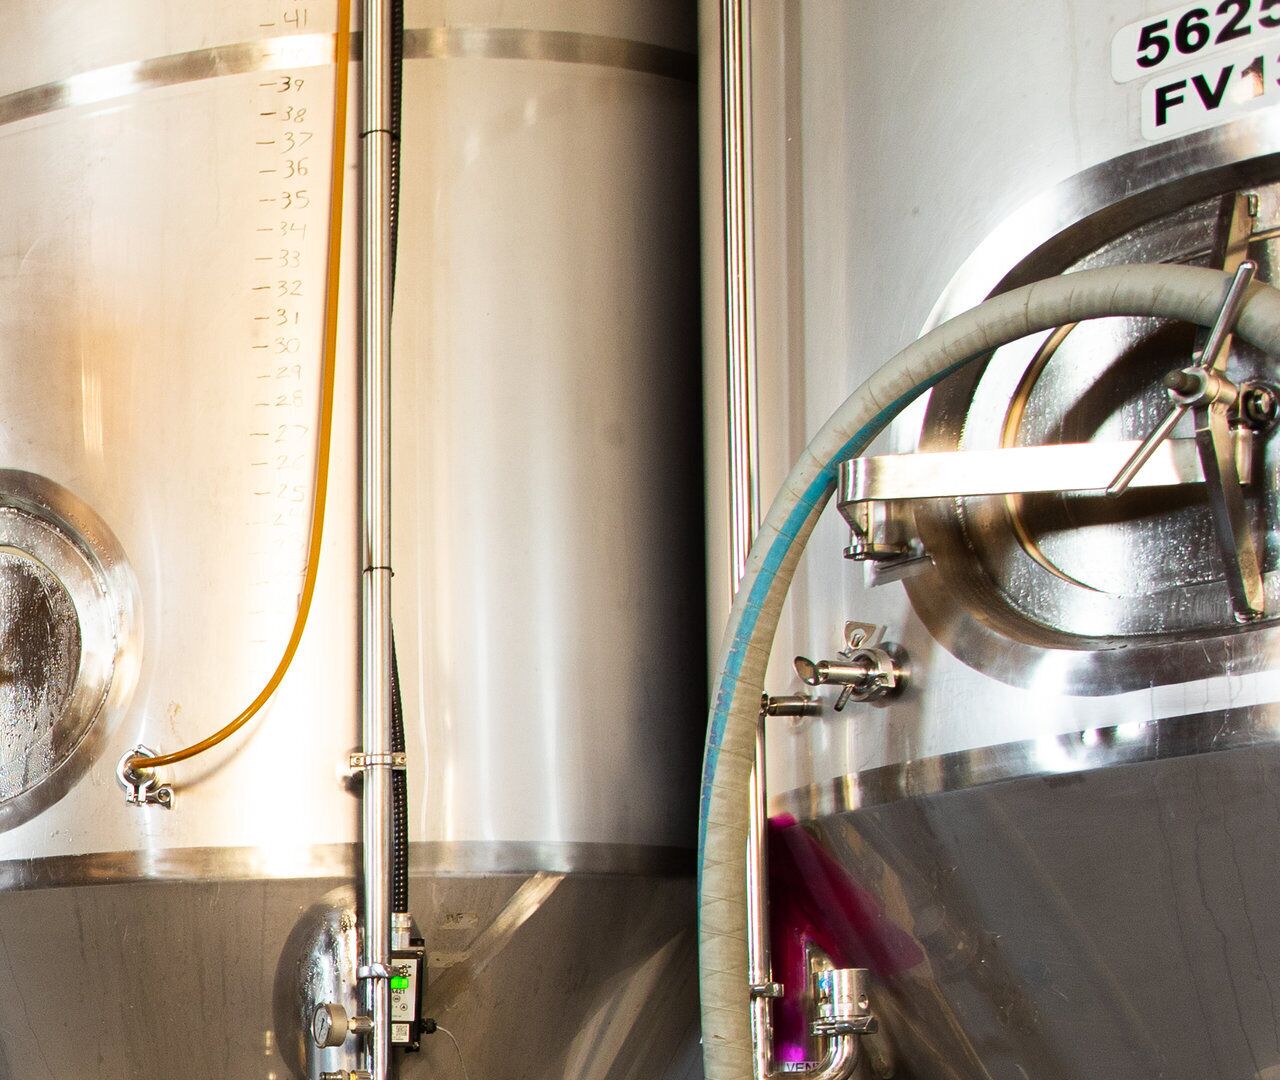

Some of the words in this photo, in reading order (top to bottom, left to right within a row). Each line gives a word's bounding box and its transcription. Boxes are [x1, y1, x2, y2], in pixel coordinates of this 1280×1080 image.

[283, 9, 307, 29] 41
[277, 76, 305, 93] 39
[1155, 55, 1280, 127] FV1
[280, 105, 307, 124] 38
[279, 132, 313, 154] 37
[283, 157, 309, 179] 36
[281, 190, 310, 209] 35
[278, 220, 307, 240] 34
[278, 248, 301, 268] 33
[276, 280, 305, 297] 32
[276, 308, 300, 325] 31
[274, 336, 301, 354] 30
